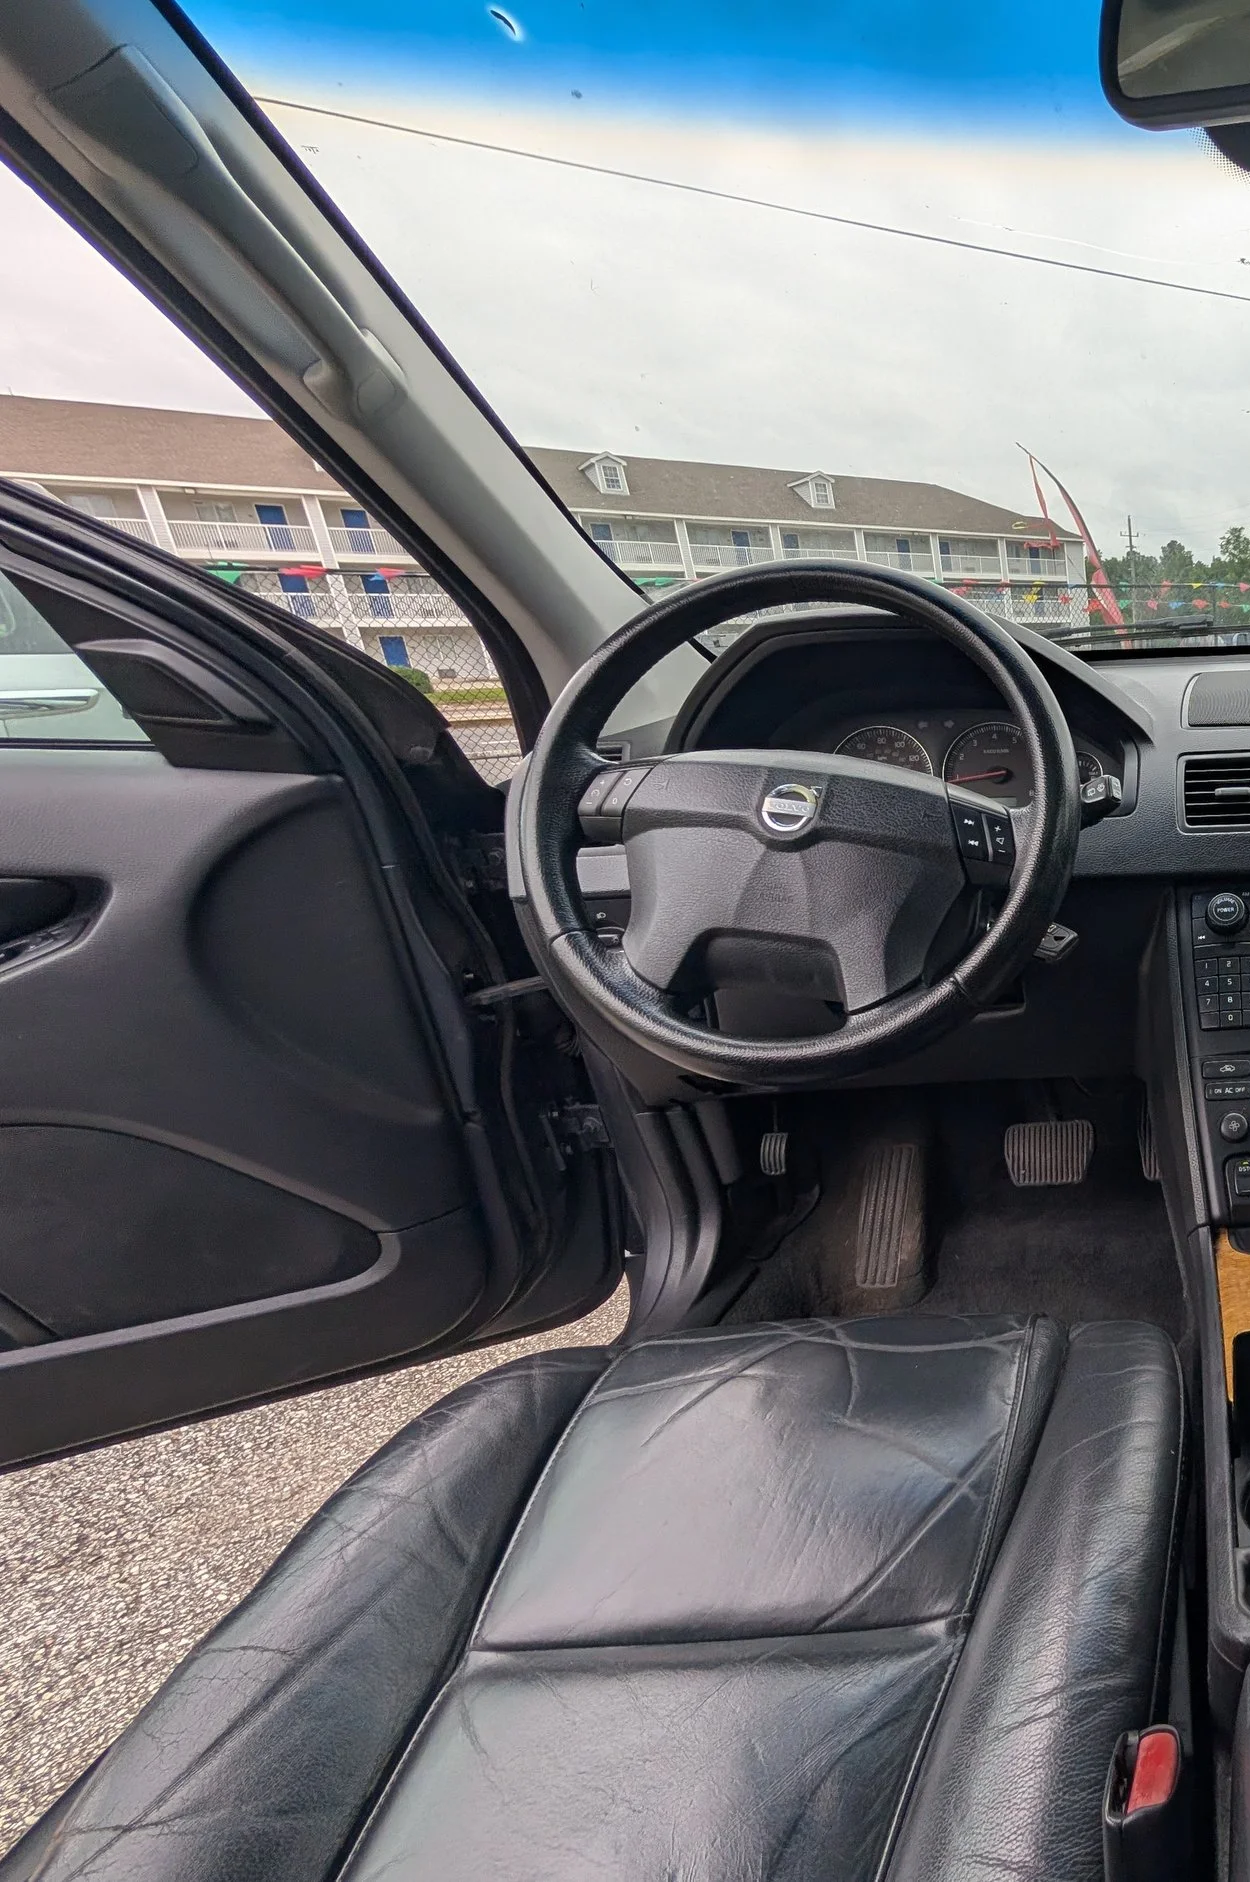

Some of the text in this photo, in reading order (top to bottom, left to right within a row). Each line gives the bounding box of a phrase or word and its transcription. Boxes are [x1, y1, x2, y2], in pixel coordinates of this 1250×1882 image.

[877, 737, 887, 745] 80
[1226, 960, 1231, 968] 2
[1227, 978, 1233, 986] 5
[1206, 998, 1211, 1006] 7
[1227, 996, 1233, 1004] 8
